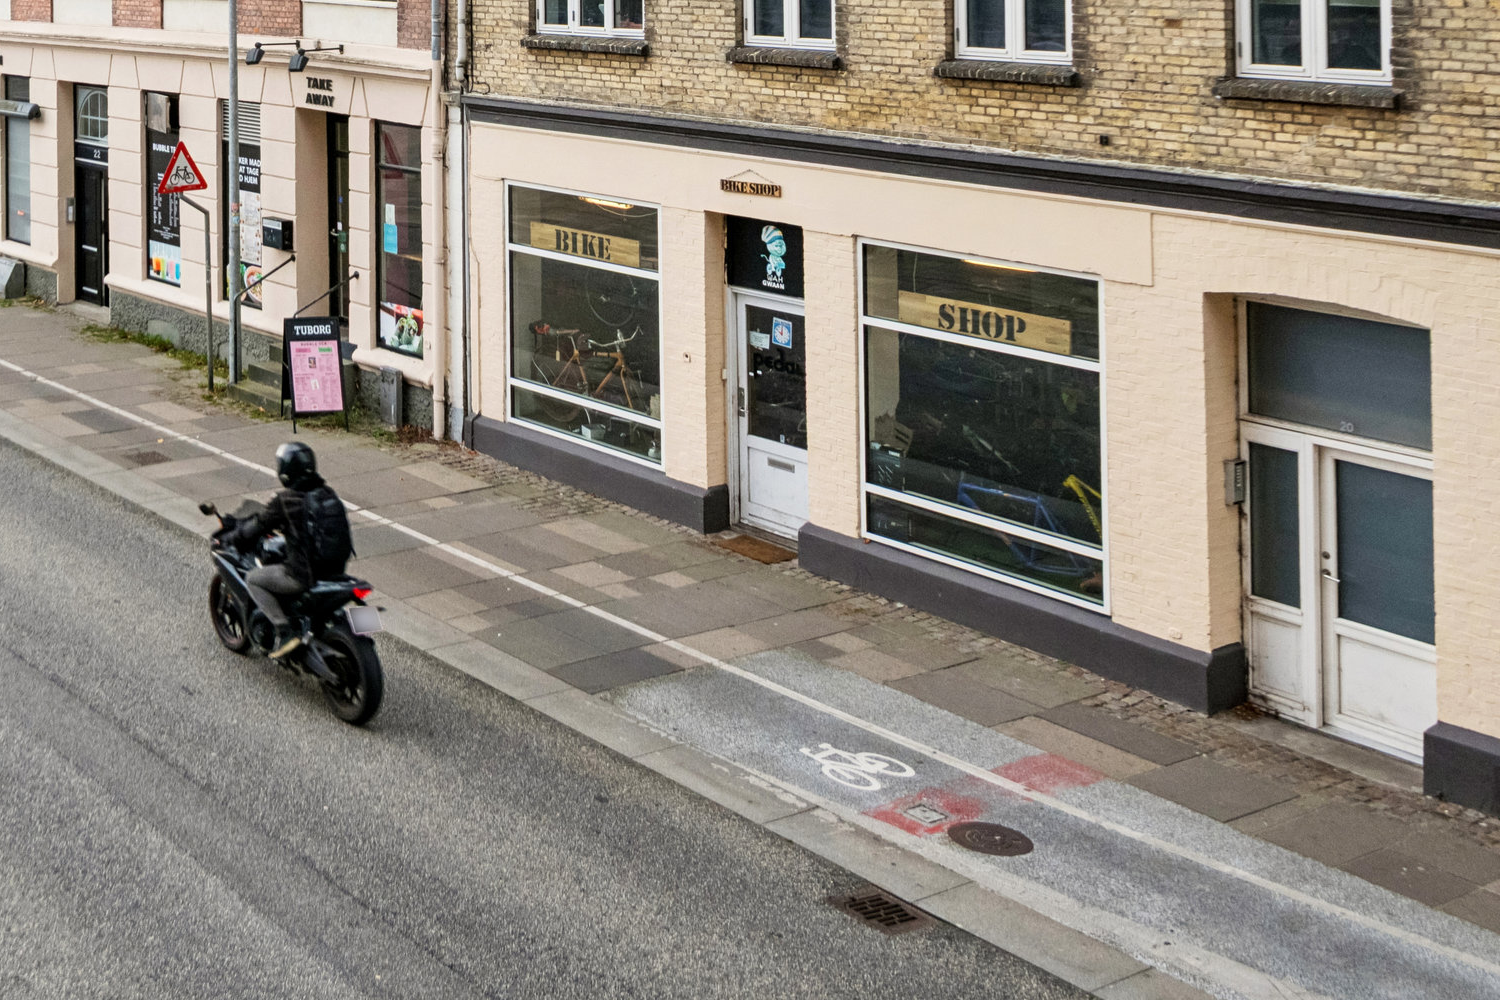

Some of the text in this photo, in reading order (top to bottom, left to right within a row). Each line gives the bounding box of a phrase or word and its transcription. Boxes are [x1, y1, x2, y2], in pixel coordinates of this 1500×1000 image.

[306, 76, 333, 91] TAKE
[305, 92, 335, 107] AWAY
[94, 149, 101, 159] 22
[721, 179, 779, 196] BIKE SHOP
[555, 229, 611, 260] BIKE
[762, 279, 785, 290] GWAAN
[767, 274, 784, 283] WAH
[938, 303, 1027, 342] SHOP
[294, 324, 332, 336] TUBORG
[1339, 421, 1354, 433] 20
